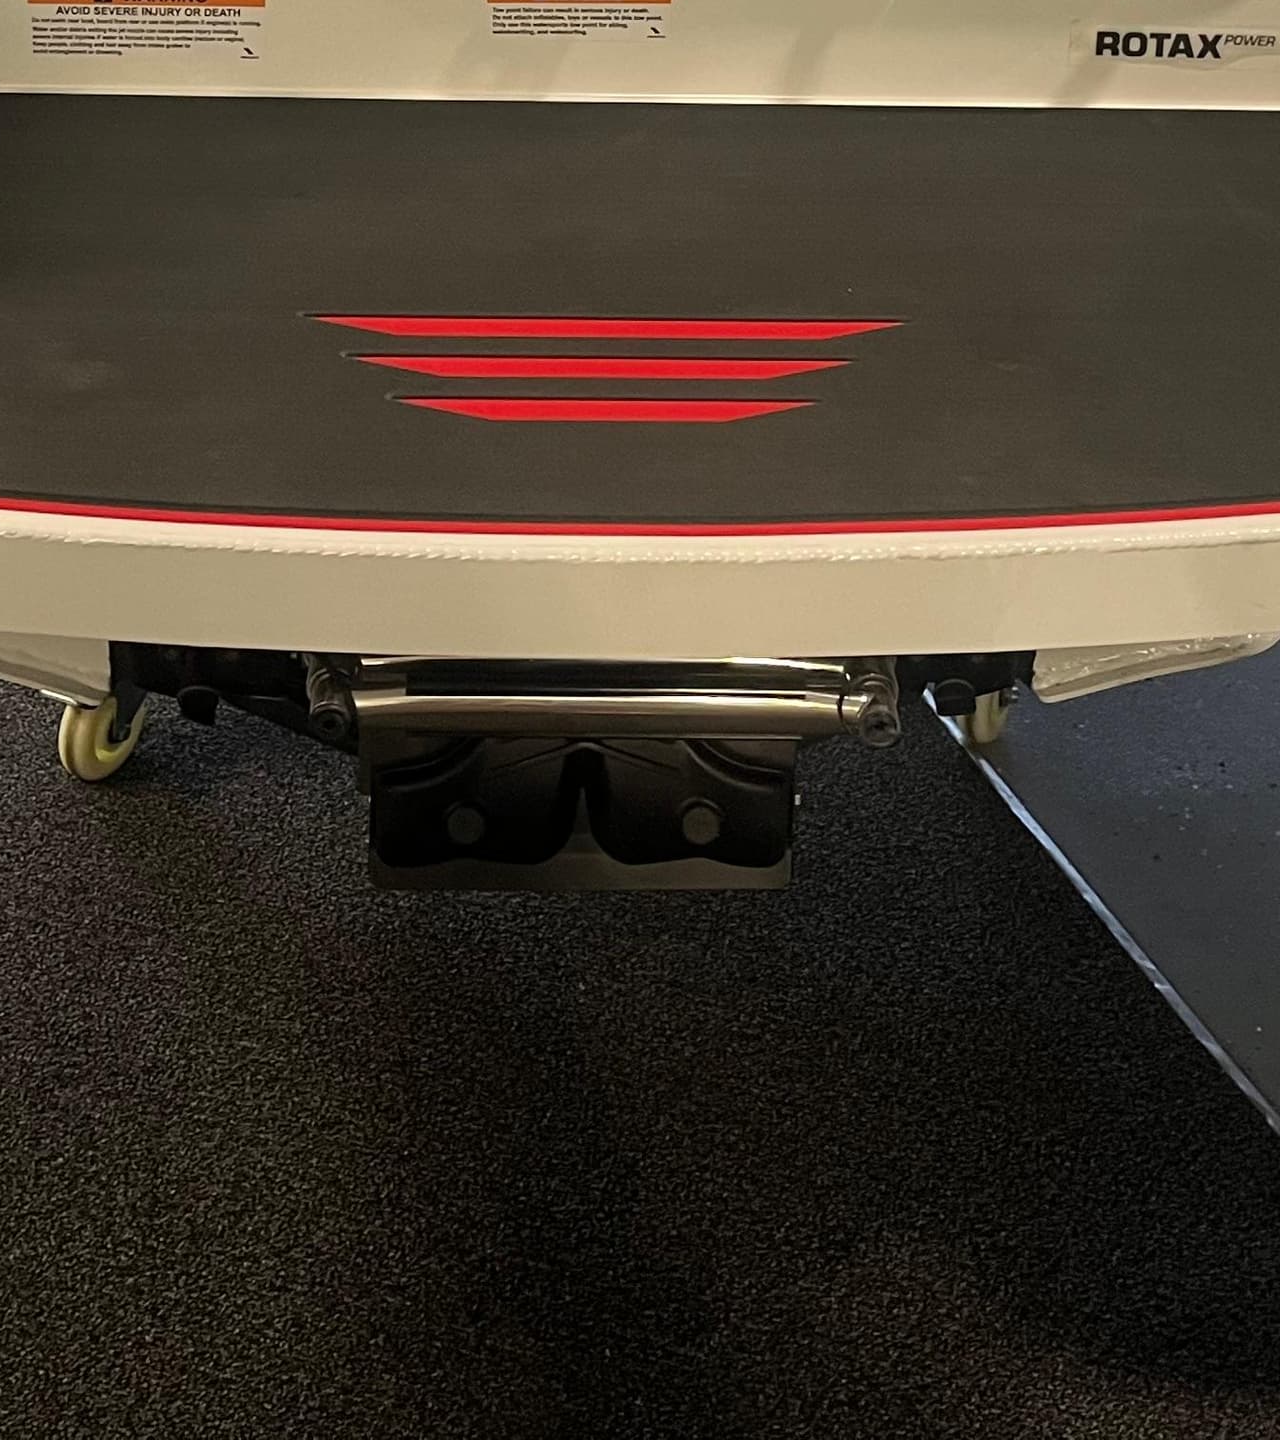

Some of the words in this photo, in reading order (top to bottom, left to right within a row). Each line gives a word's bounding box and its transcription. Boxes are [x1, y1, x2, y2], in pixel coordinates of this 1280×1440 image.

[56, 6, 90, 15] AVOID
[93, 6, 138, 16] SEVERE
[141, 7, 181, 17] INJURY
[184, 8, 201, 17] OR
[204, 8, 241, 18] DEATH
[1095, 31, 1223, 59] ROTAX
[1223, 34, 1277, 48] POWER
